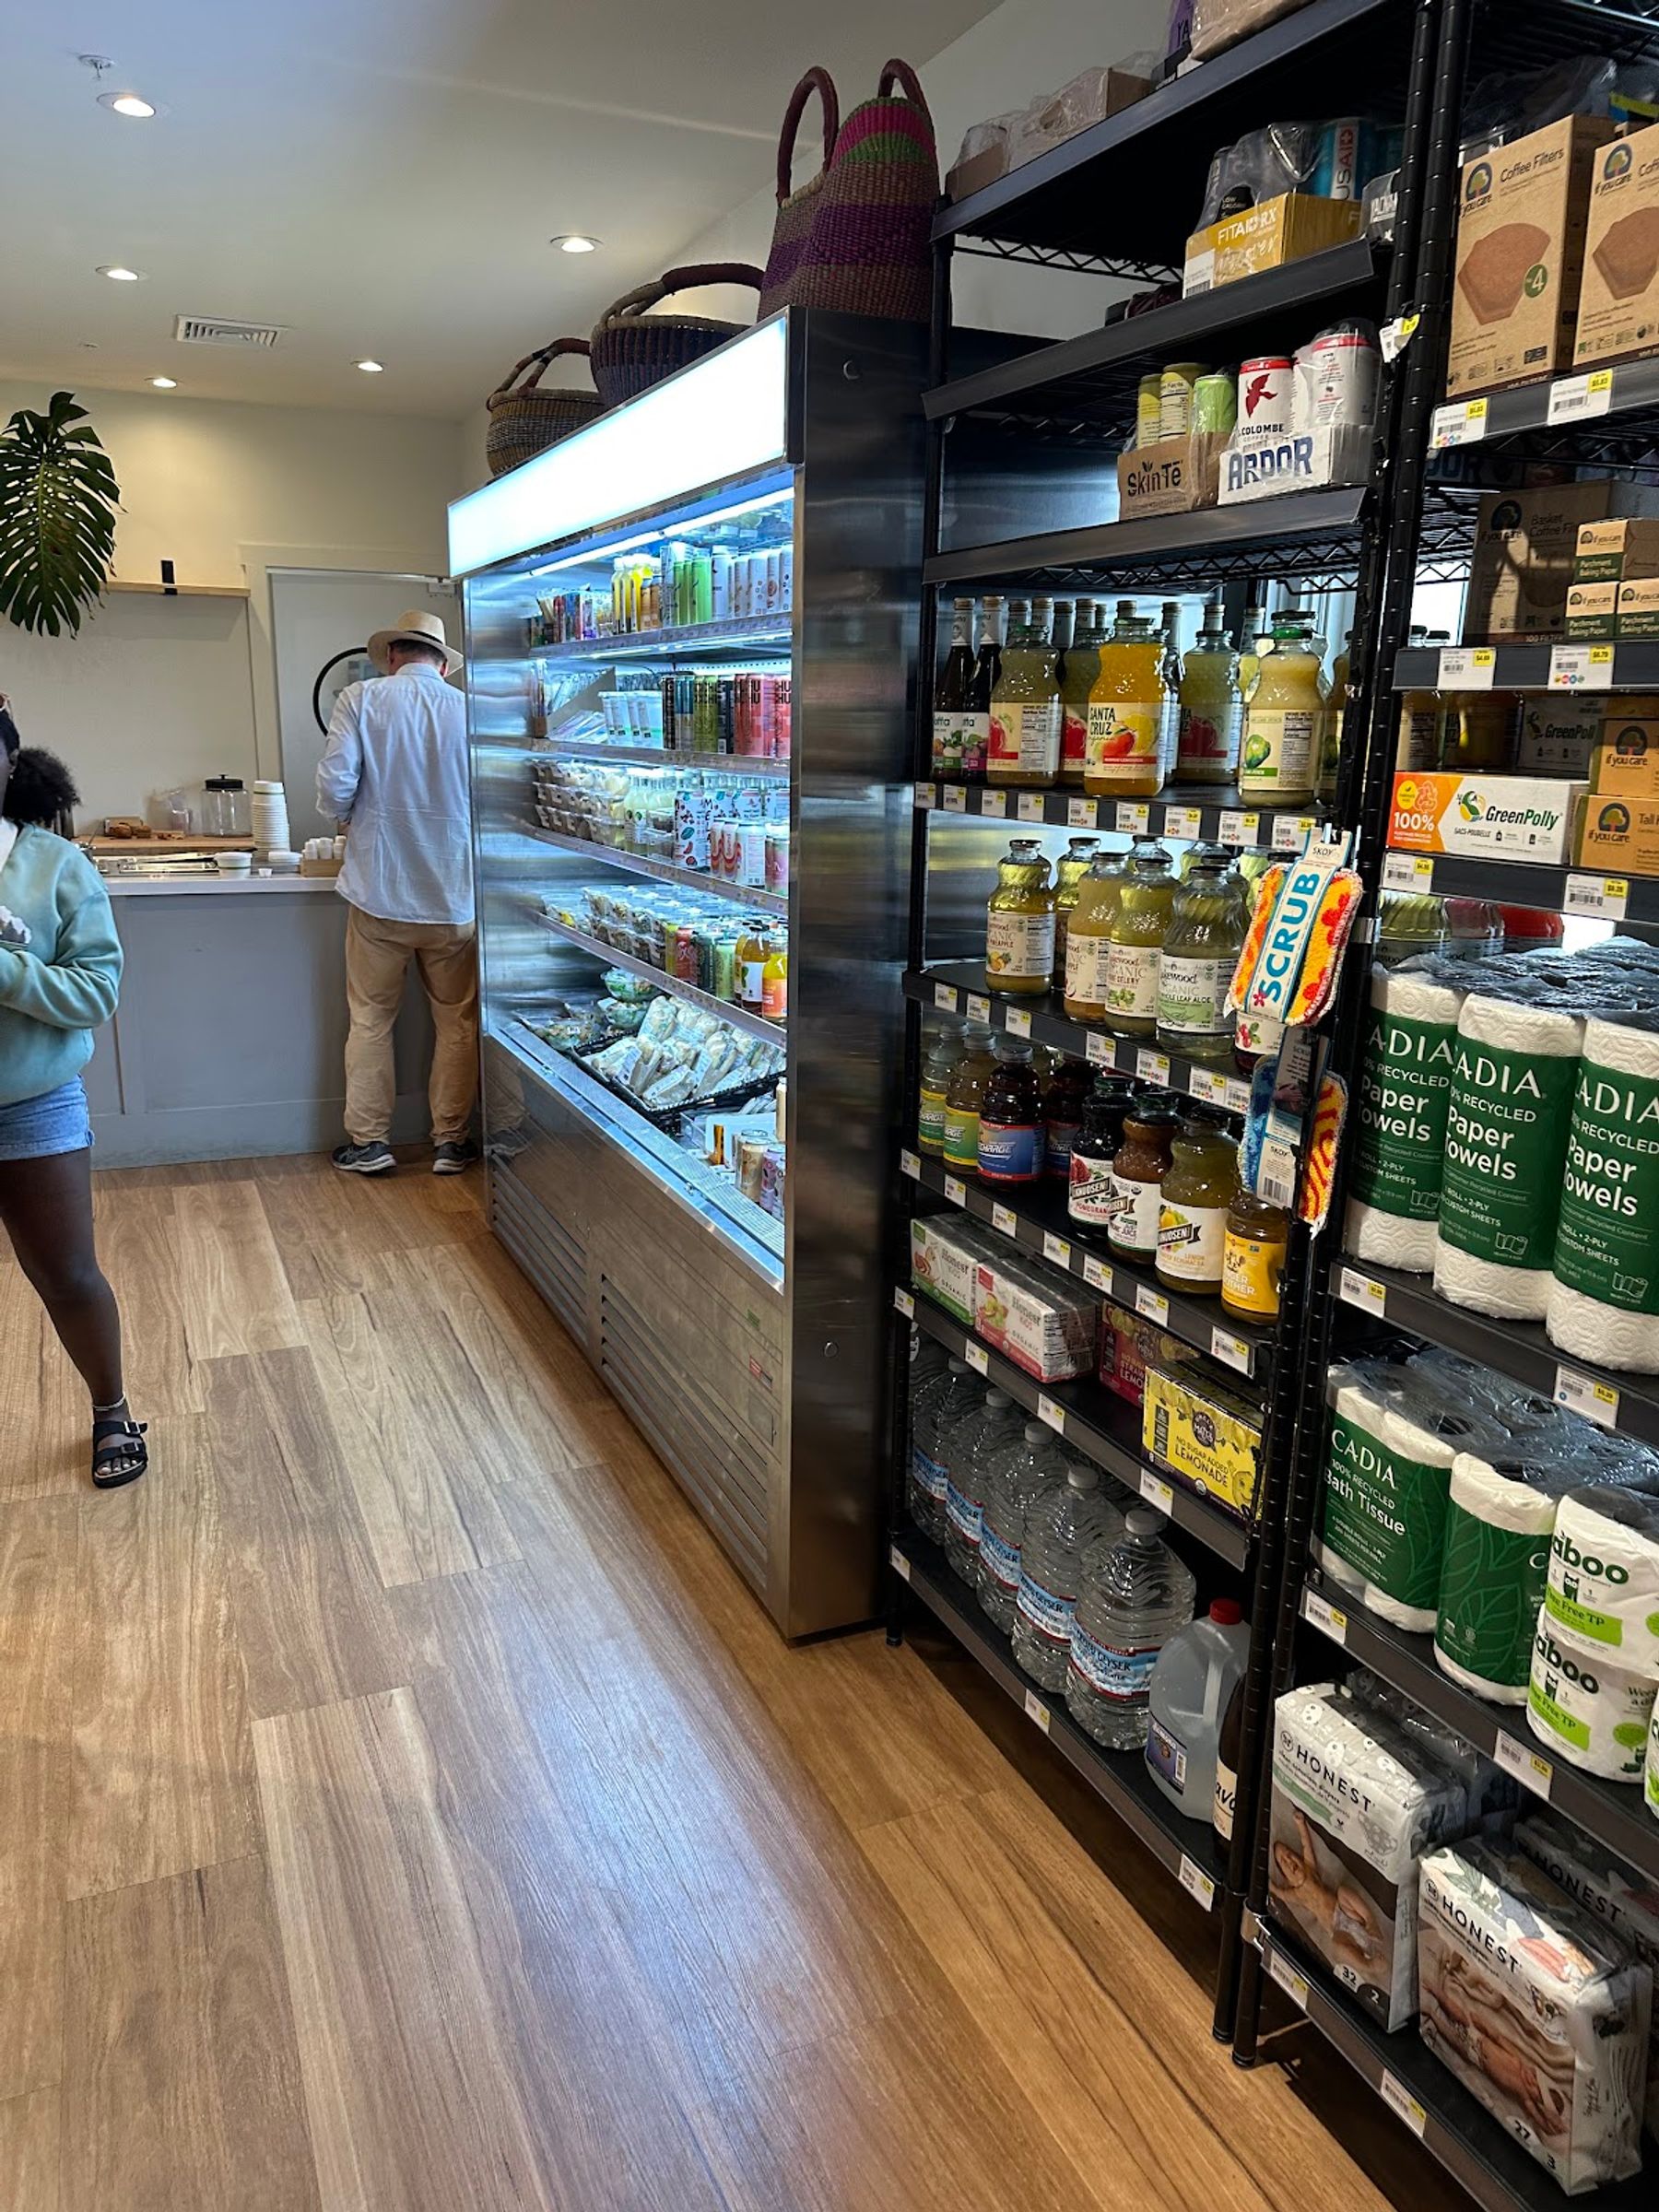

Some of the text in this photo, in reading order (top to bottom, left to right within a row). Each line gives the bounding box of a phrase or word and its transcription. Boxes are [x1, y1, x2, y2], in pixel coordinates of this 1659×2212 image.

[1500, 161, 1531, 182] Coffee
[1534, 269, 1544, 292] 4
[1241, 423, 1284, 436] COLOMBE
[1546, 724, 1596, 741] GreenPoll
[1394, 811, 1435, 831] 100%
[1486, 806, 1560, 831] GreenPolly
[1312, 845, 1333, 858] SKOY
[1259, 873, 1321, 1005] SCRUB
[1365, 1023, 1454, 1066] ADIA
[1376, 1063, 1450, 1088] RECYCLED
[1453, 1050, 1543, 1100] ADIA
[1360, 1074, 1430, 1114] Paper
[1462, 1093, 1537, 1124] RECYCLED
[1575, 1067, 1659, 1125] ADIA
[1448, 1105, 1516, 1150] Paper
[1581, 1120, 1659, 1155] RECYCLED
[1568, 1133, 1638, 1183] Paper
[1586, 1247, 1620, 1267] SHEETS
[1119, 1368, 1145, 1389] LEMO
[1174, 1443, 1229, 1488] LEMONADE
[1206, 1454, 1230, 1475] ADDED
[1332, 1430, 1397, 1490] CADIA
[1324, 1466, 1354, 1502] Bath
[1358, 1489, 1406, 1536] Tissue
[1331, 1458, 1396, 1510] 100% RECYCLED
[1552, 1531, 1630, 1585] aboo
[1565, 1598, 1586, 1620] Free
[1585, 1611, 1606, 1627] TP
[1536, 1632, 1600, 1695] aboo
[1296, 1744, 1372, 1813] HONEST
[1534, 1851, 1623, 1924] HONEST
[1442, 1895, 1519, 1974] HONEST
[1341, 1965, 1358, 1985] 32
[1370, 1990, 1381, 2004] 2
[1513, 2120, 1531, 2140] 27
